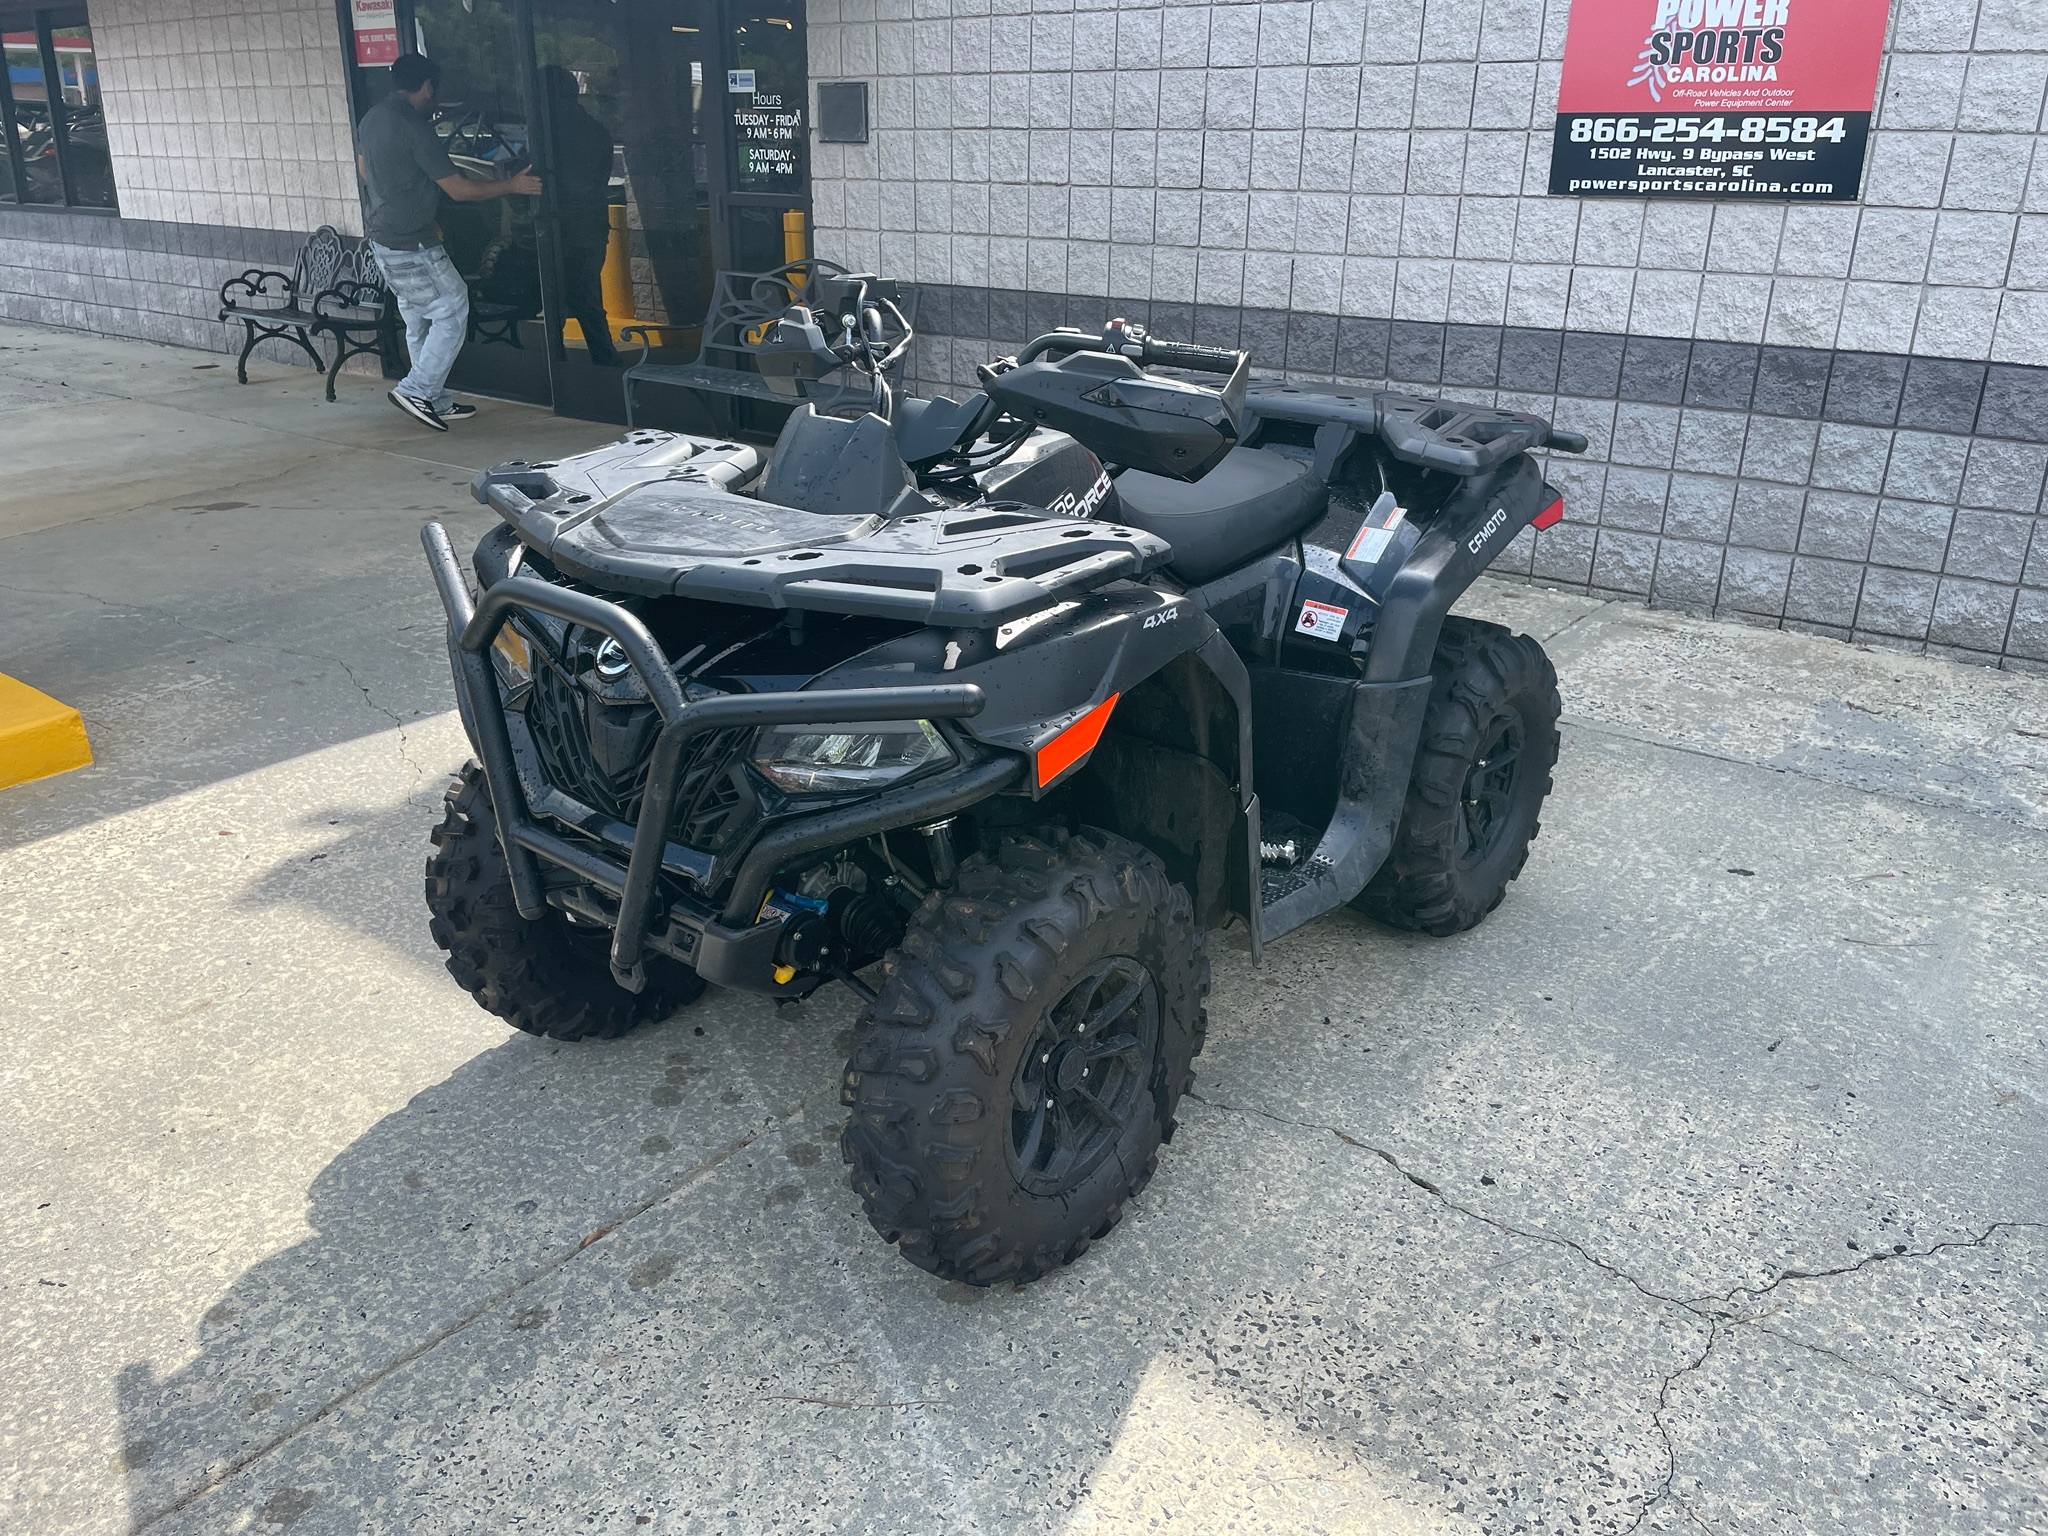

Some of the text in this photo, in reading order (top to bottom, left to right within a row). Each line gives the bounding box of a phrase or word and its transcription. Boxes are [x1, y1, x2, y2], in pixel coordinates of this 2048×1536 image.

[355, 0, 393, 12] Kawasaki
[1655, 0, 1790, 29] POWER
[1649, 27, 1785, 66] SPORTS
[1666, 65, 1778, 83] CAROLINA
[752, 92, 782, 106] Hours
[1672, 88, 1795, 98] Off-Road Vehicles And Outdoor
[1693, 99, 1793, 108] Power Equipment Center
[734, 114, 769, 126] TUESDAY
[746, 127, 752, 139] 9
[753, 127, 768, 139] AM
[773, 127, 779, 139] 6
[779, 127, 793, 140] PM
[1570, 117, 1847, 143] 866-254-8584
[749, 148, 791, 161] SATURDAY
[1590, 147, 1816, 162] 1502 Hwy. 9 Bypass West
[748, 161, 755, 173] 9
[755, 161, 770, 174] AM
[775, 162, 793, 175] 4PM
[1637, 164, 1754, 178] Lancaster, SC
[1569, 179, 1833, 194] powersportscarolina.com
[1068, 470, 1112, 519] ORCE
[1467, 508, 1507, 554] CFMOTO
